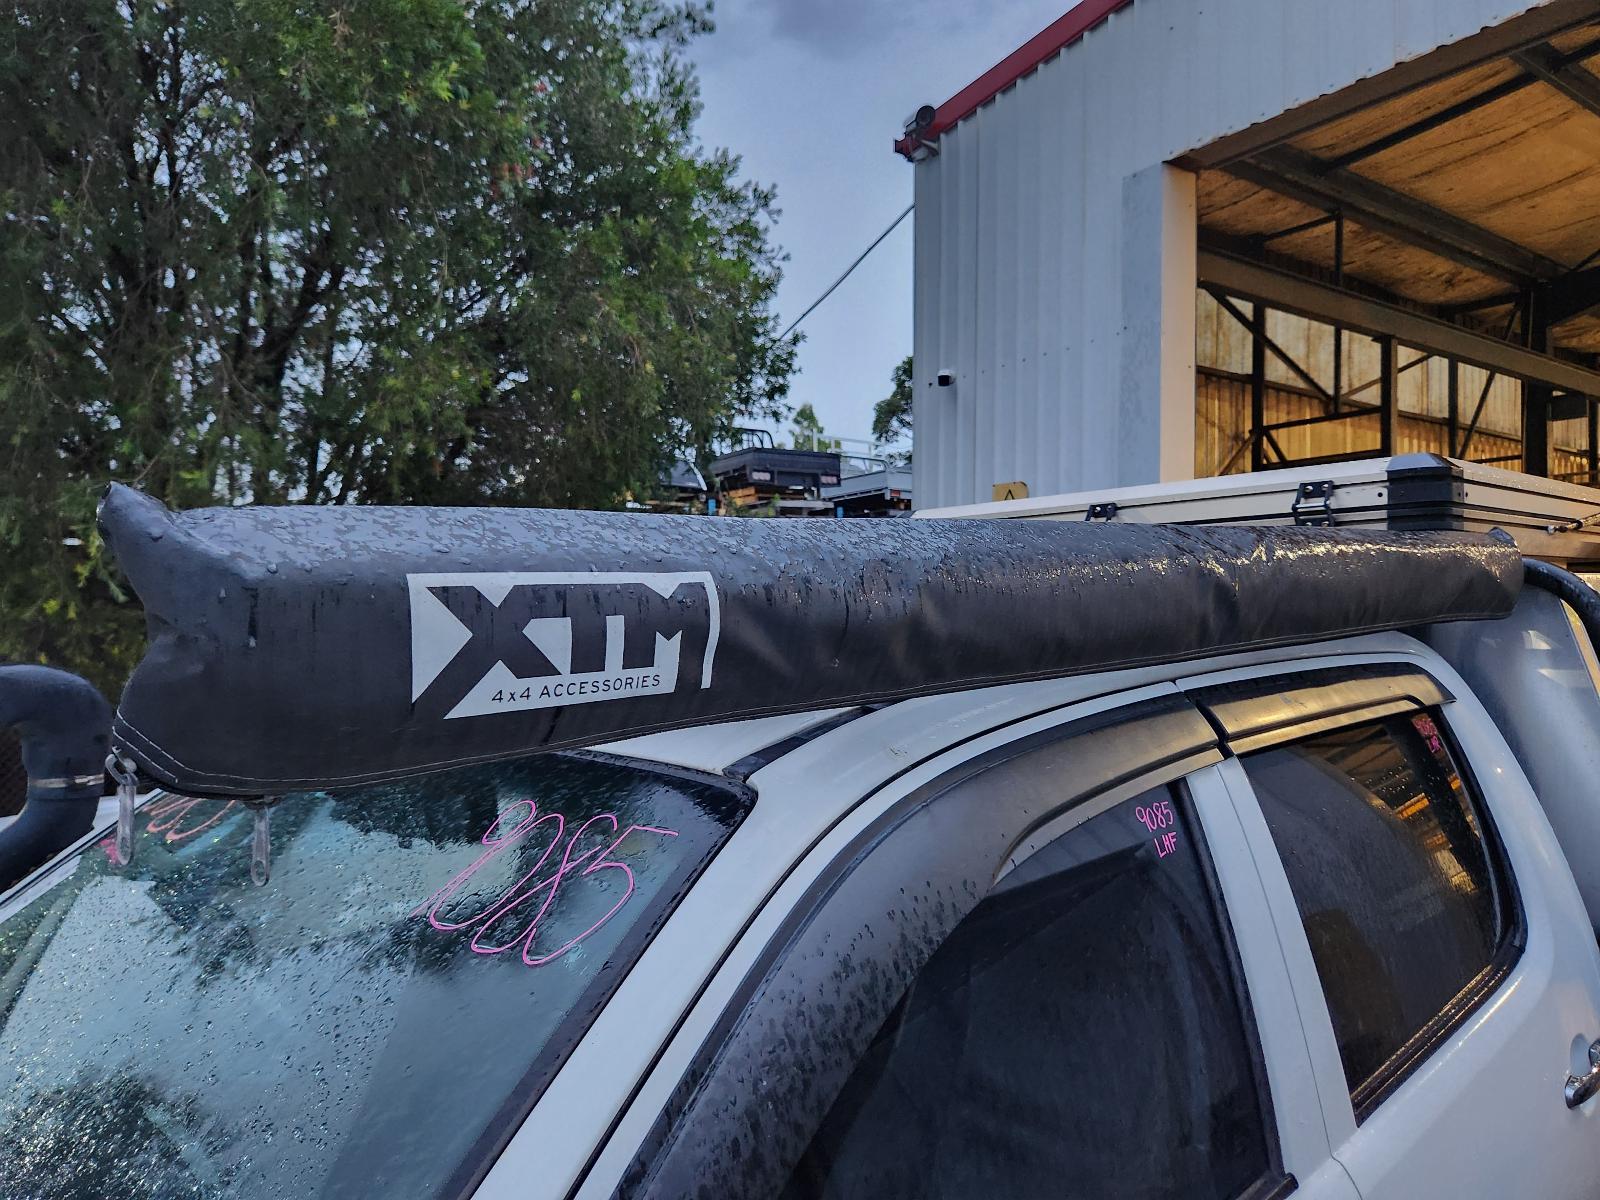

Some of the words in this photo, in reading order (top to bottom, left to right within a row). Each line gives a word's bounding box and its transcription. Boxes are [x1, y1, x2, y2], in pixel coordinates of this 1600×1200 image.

[412, 581, 712, 717] XTM
[492, 687, 532, 703] 4x4
[539, 674, 661, 699] ACCESSORIES
[1135, 801, 1174, 833] 9085
[1154, 831, 1177, 858] LHF
